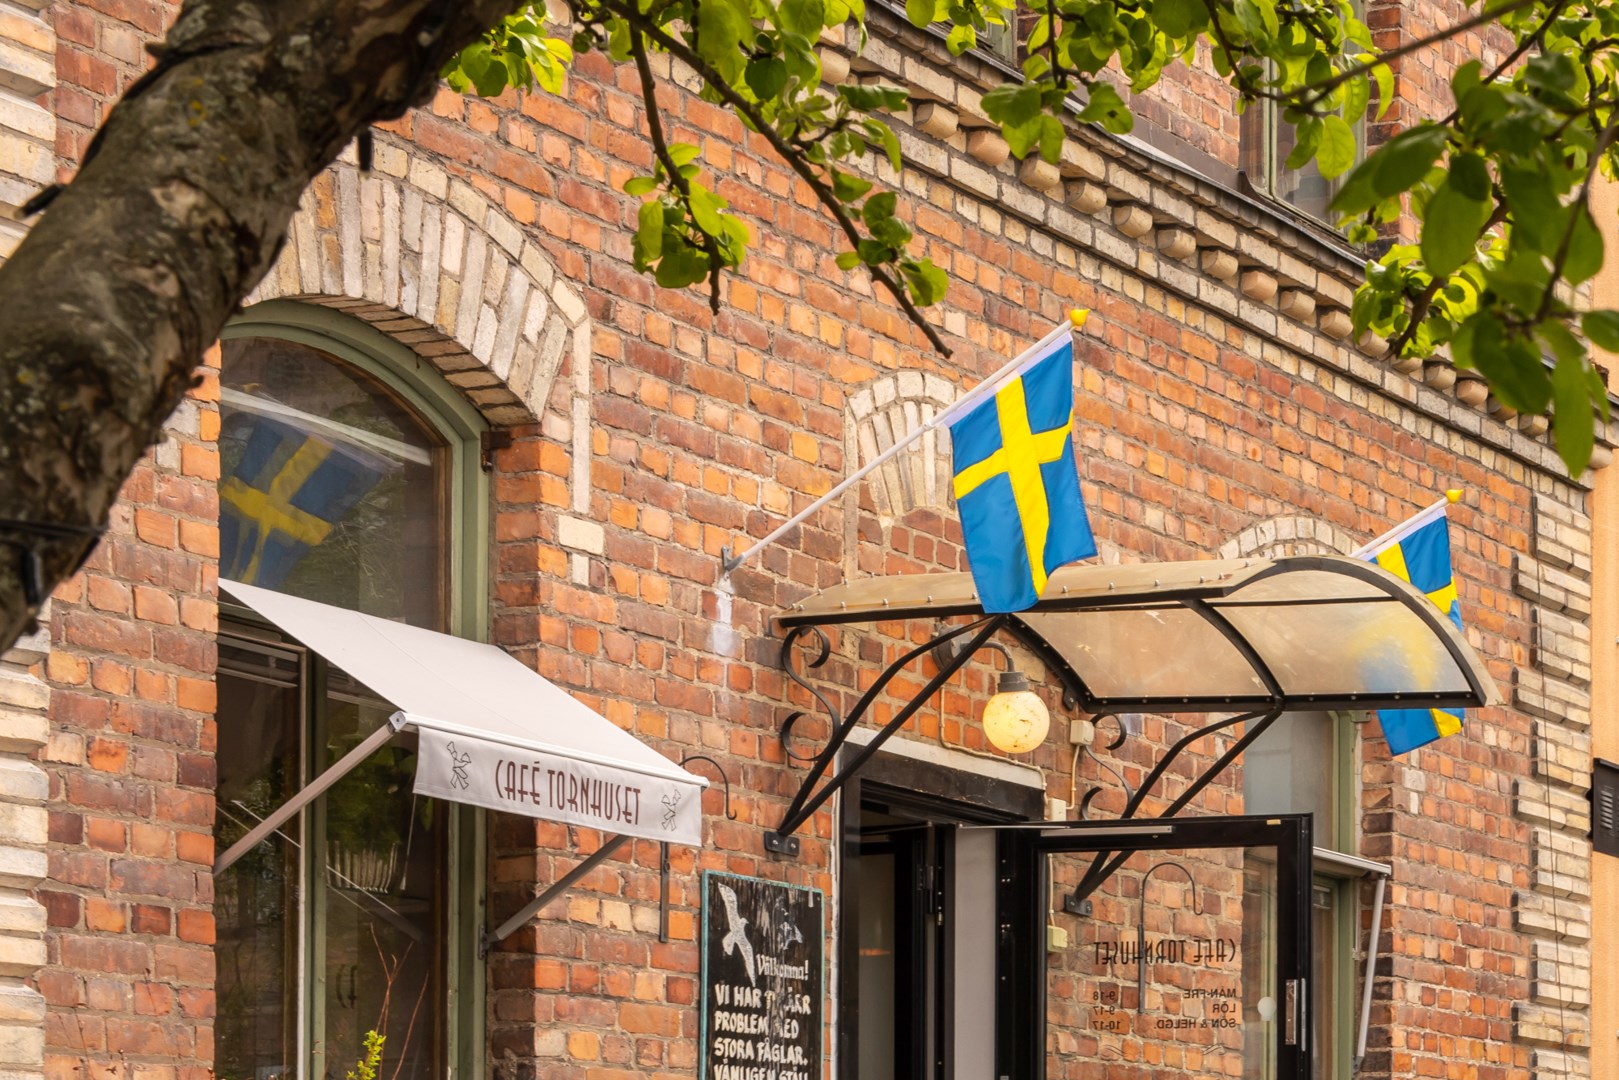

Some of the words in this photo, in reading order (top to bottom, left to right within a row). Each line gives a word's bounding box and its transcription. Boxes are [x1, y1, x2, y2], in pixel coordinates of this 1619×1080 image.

[495, 759, 541, 806] CAFÉ
[547, 769, 641, 826] TORNHUSET
[714, 983, 730, 1007] VI
[733, 986, 762, 1009] HAR
[714, 1010, 770, 1036] PROBLEM
[714, 1037, 755, 1061] STORA
[756, 1037, 808, 1066] FÅGLAR.
